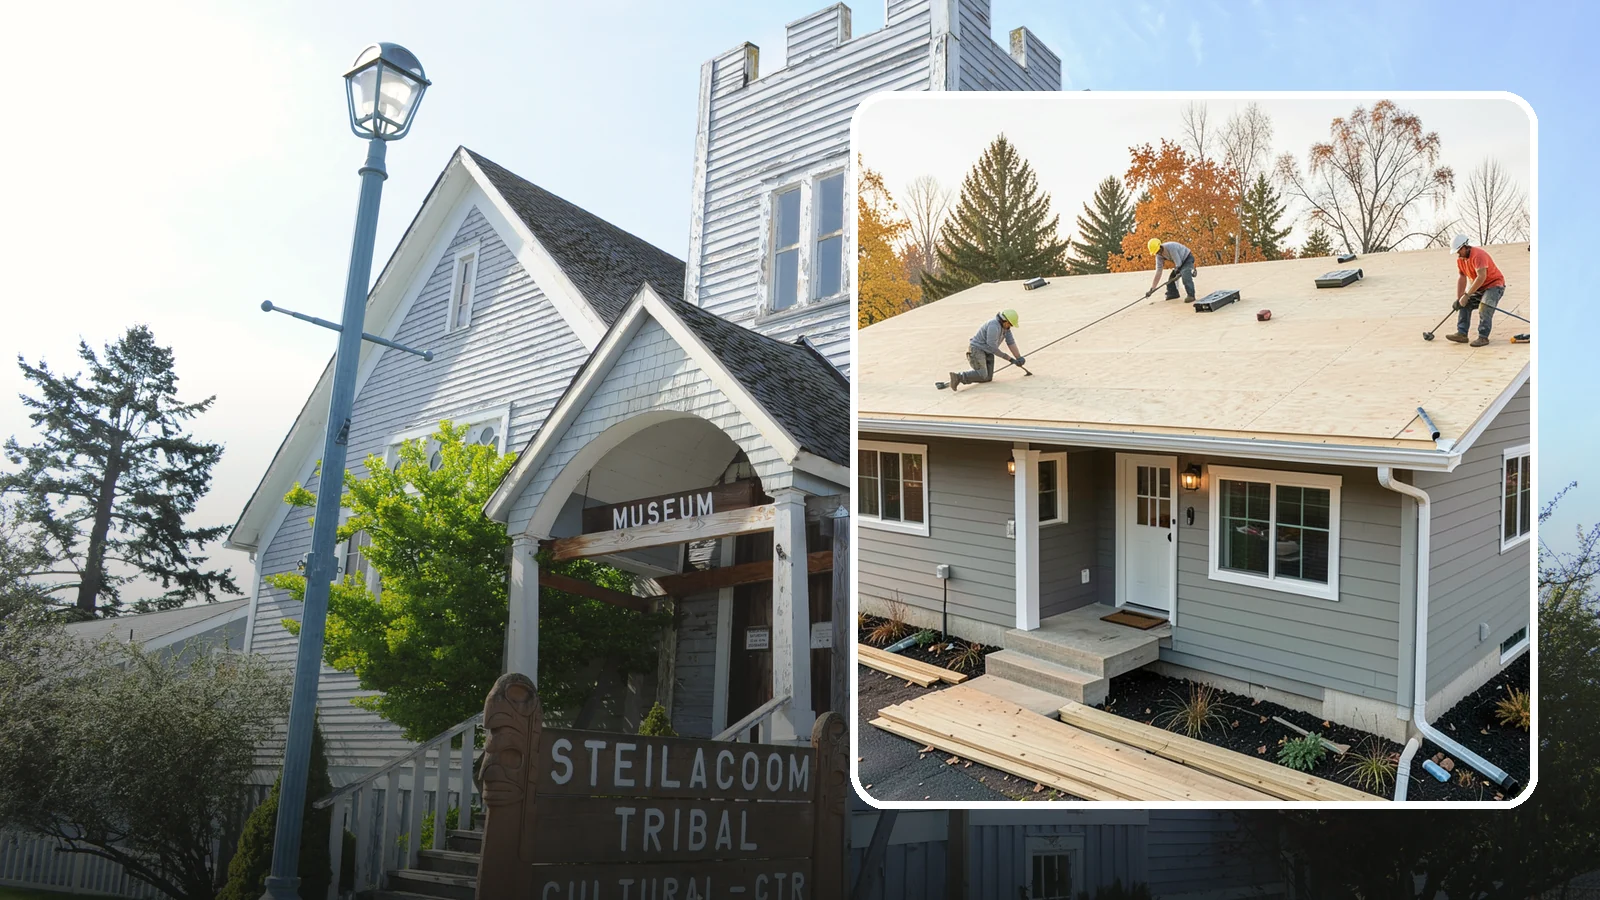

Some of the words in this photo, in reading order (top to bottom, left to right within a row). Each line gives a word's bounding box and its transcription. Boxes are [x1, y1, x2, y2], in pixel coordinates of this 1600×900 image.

[613, 491, 714, 530] MUSEUM
[551, 738, 810, 792] STEILACOOM
[615, 807, 758, 851] TRIBAL
